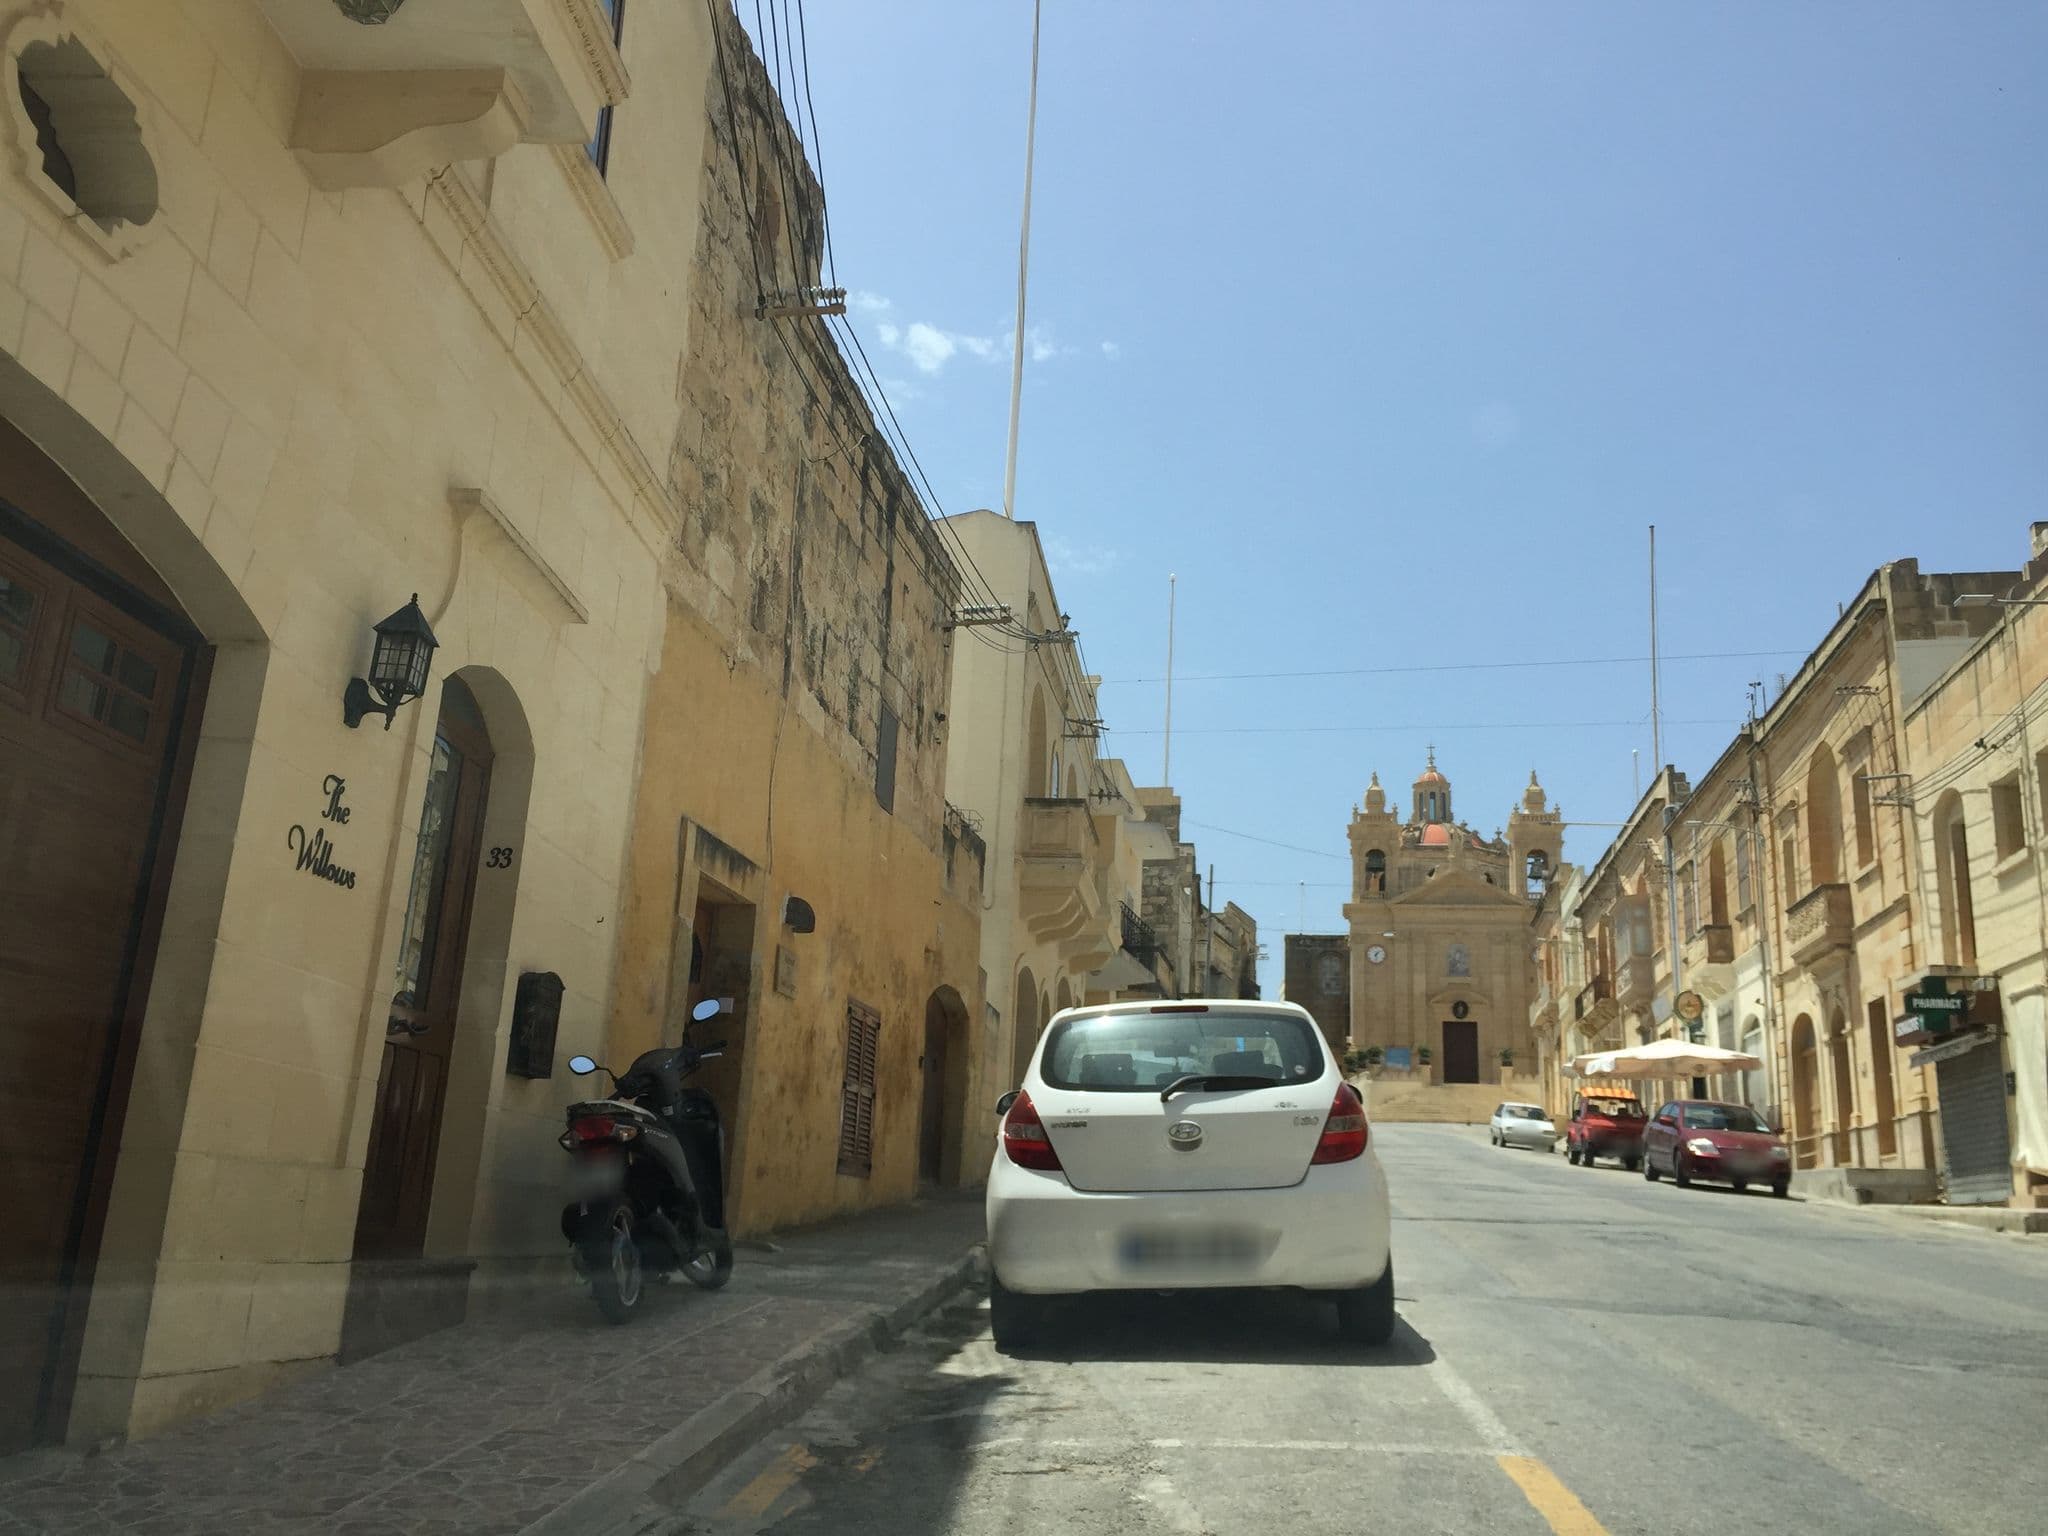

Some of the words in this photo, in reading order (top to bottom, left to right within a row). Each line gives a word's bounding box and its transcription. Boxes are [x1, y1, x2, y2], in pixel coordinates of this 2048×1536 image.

[321, 774, 350, 824] The
[288, 825, 356, 889] Willows
[486, 847, 513, 869] 33
[1912, 997, 1962, 1009] PHARMACY
